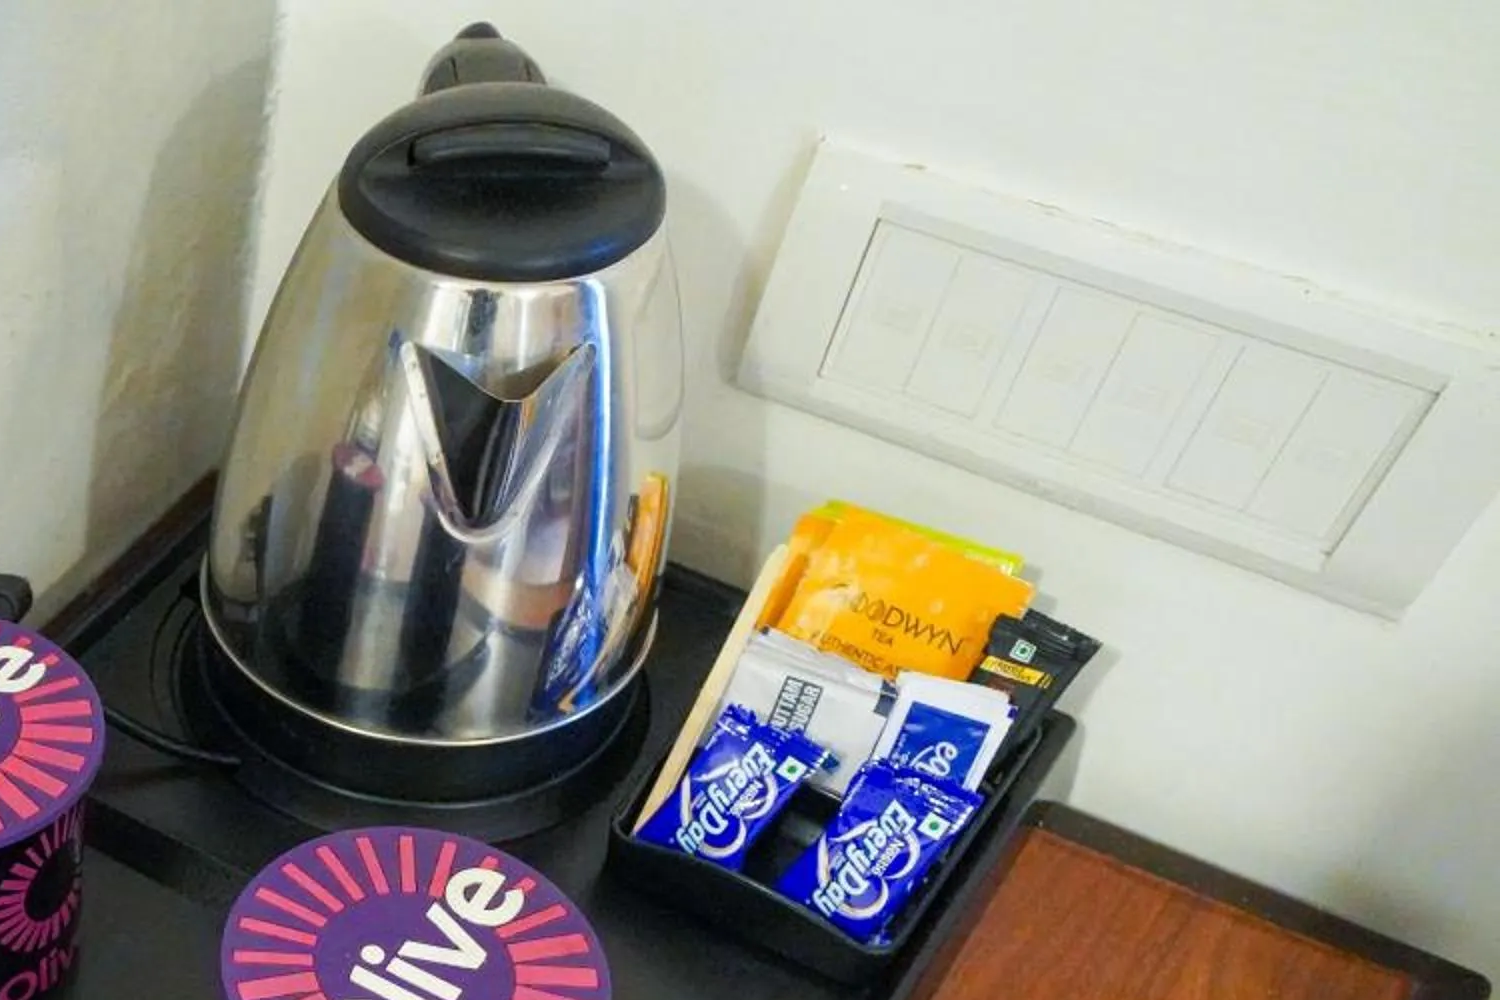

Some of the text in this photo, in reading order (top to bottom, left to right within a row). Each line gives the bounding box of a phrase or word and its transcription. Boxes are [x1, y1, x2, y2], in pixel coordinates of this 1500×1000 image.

[831, 582, 965, 656] OODWYN
[871, 628, 894, 647] TEA
[812, 799, 917, 917] EveryDay
